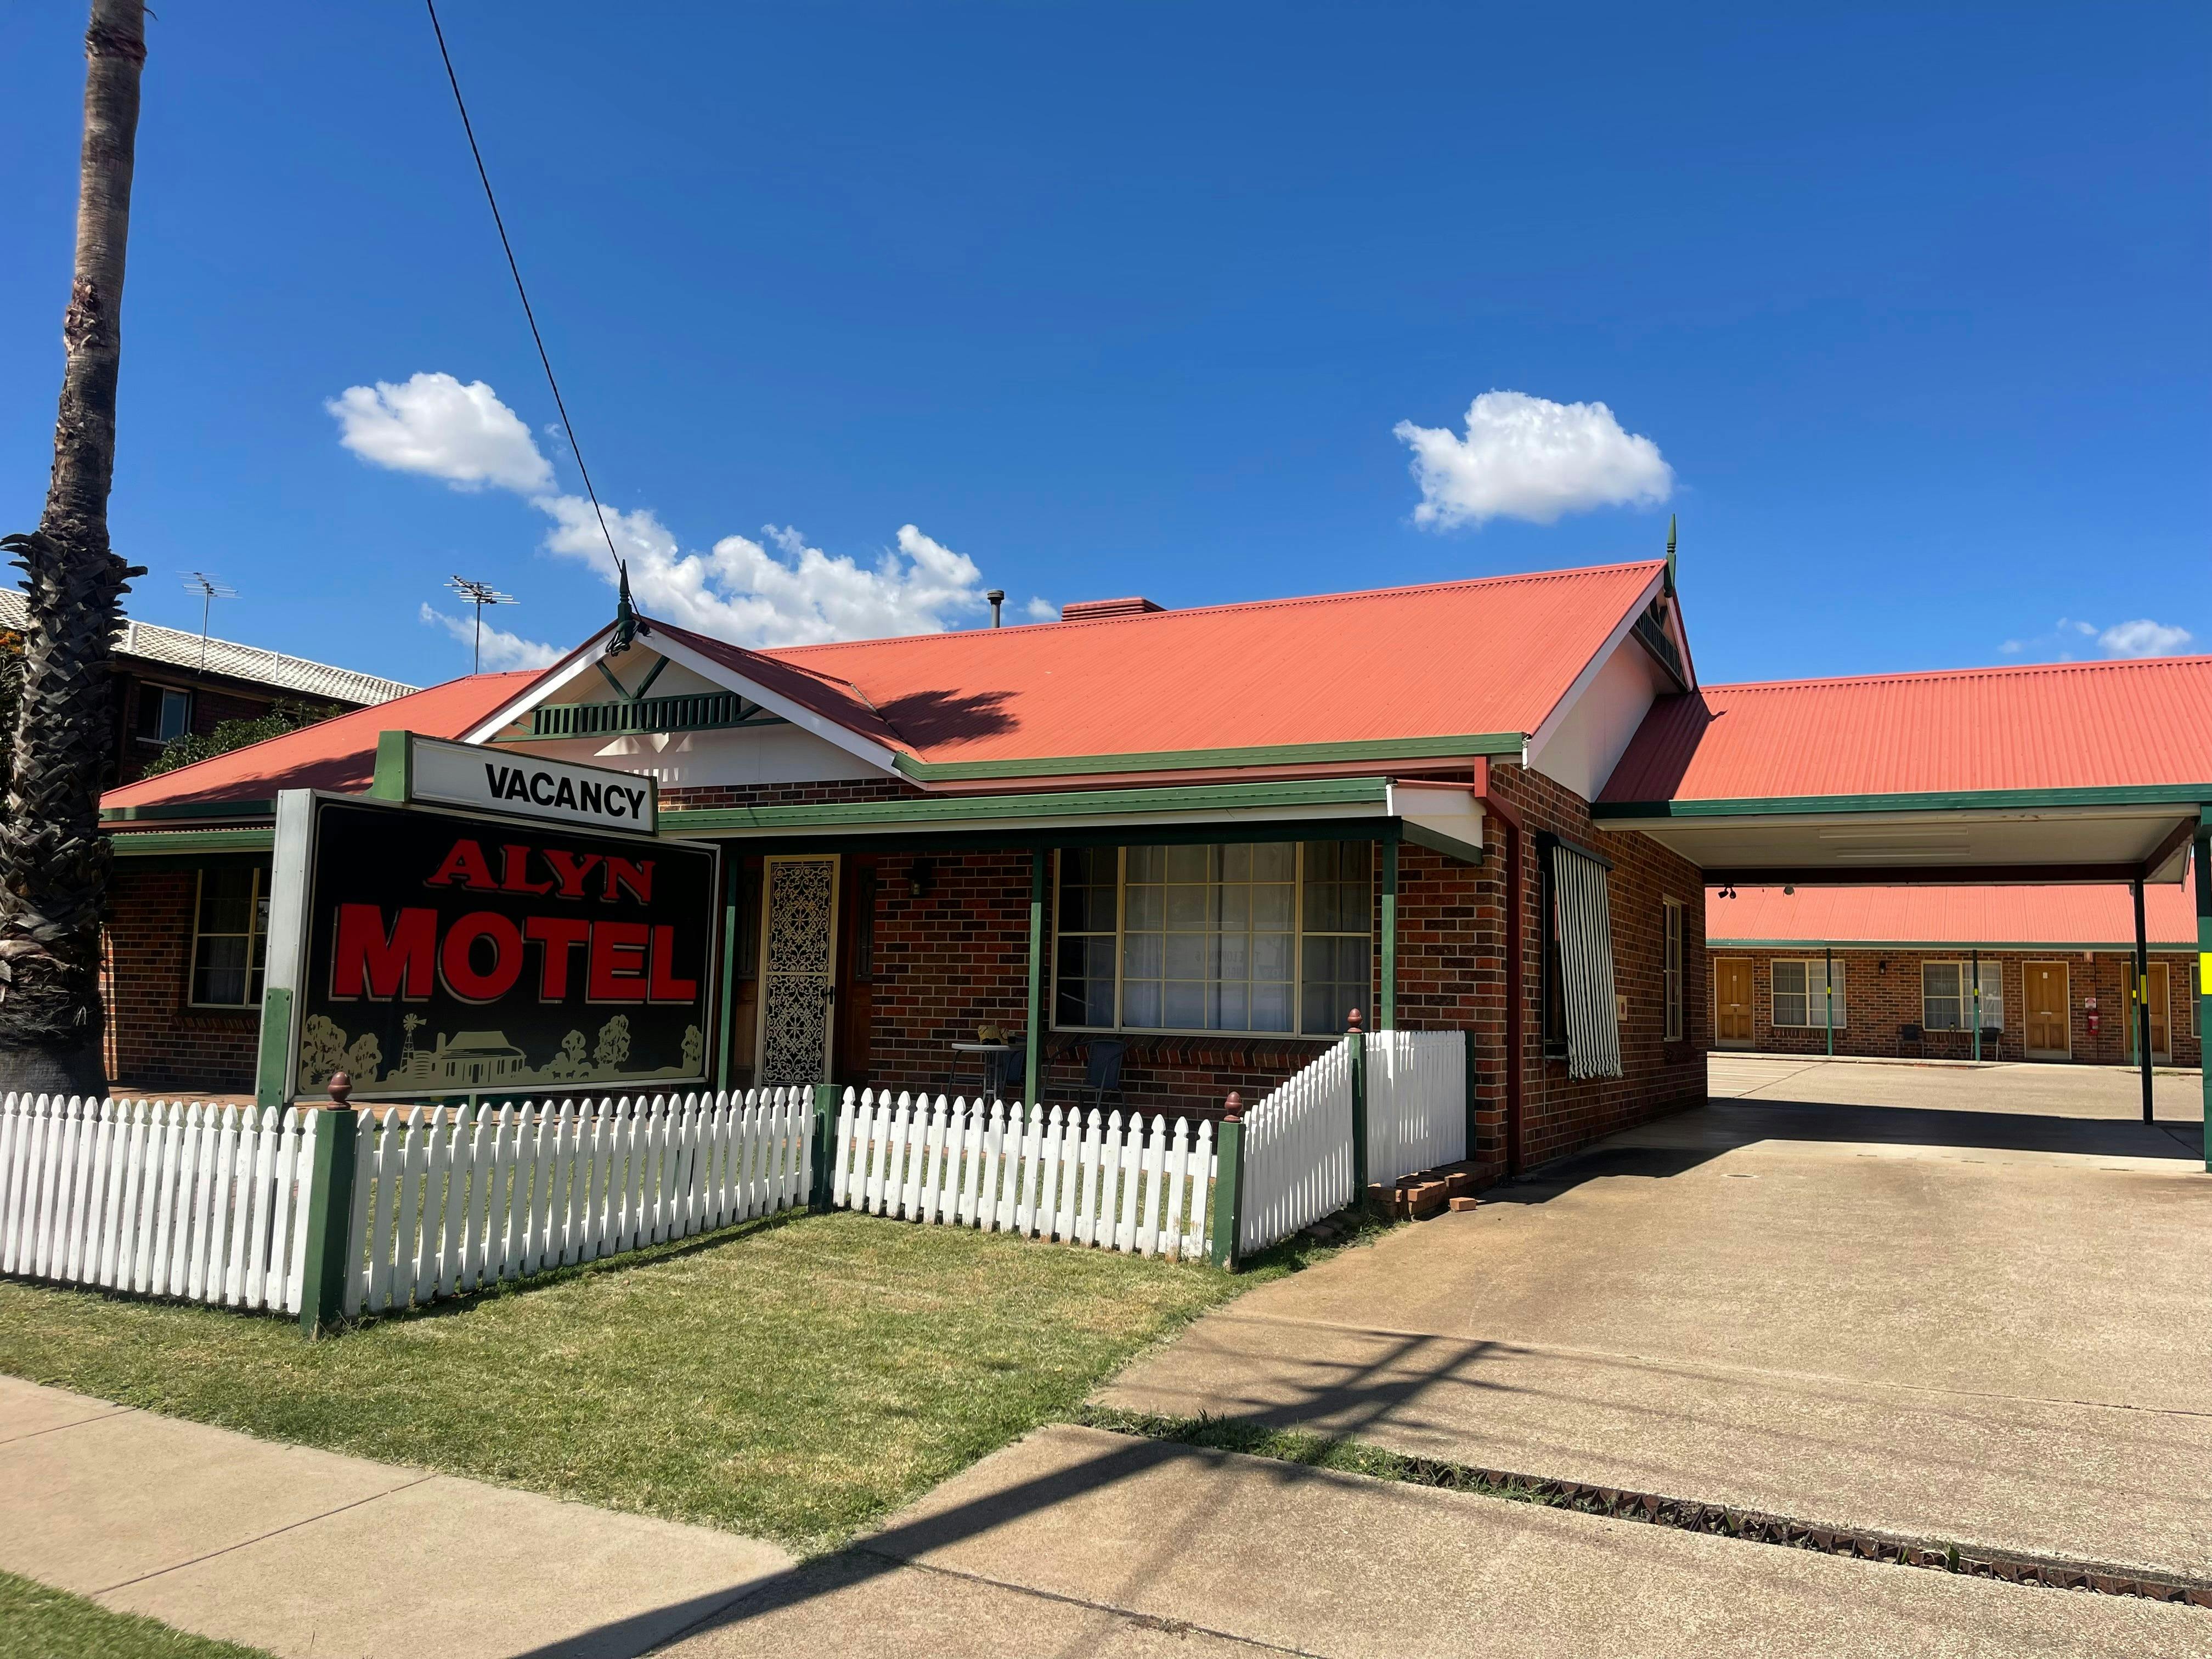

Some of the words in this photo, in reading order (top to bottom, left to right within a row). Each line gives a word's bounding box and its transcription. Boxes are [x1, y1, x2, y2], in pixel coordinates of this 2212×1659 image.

[484, 763, 646, 820] VACANCY
[426, 838, 656, 903] ALYN
[332, 902, 697, 1002] MOTEL
